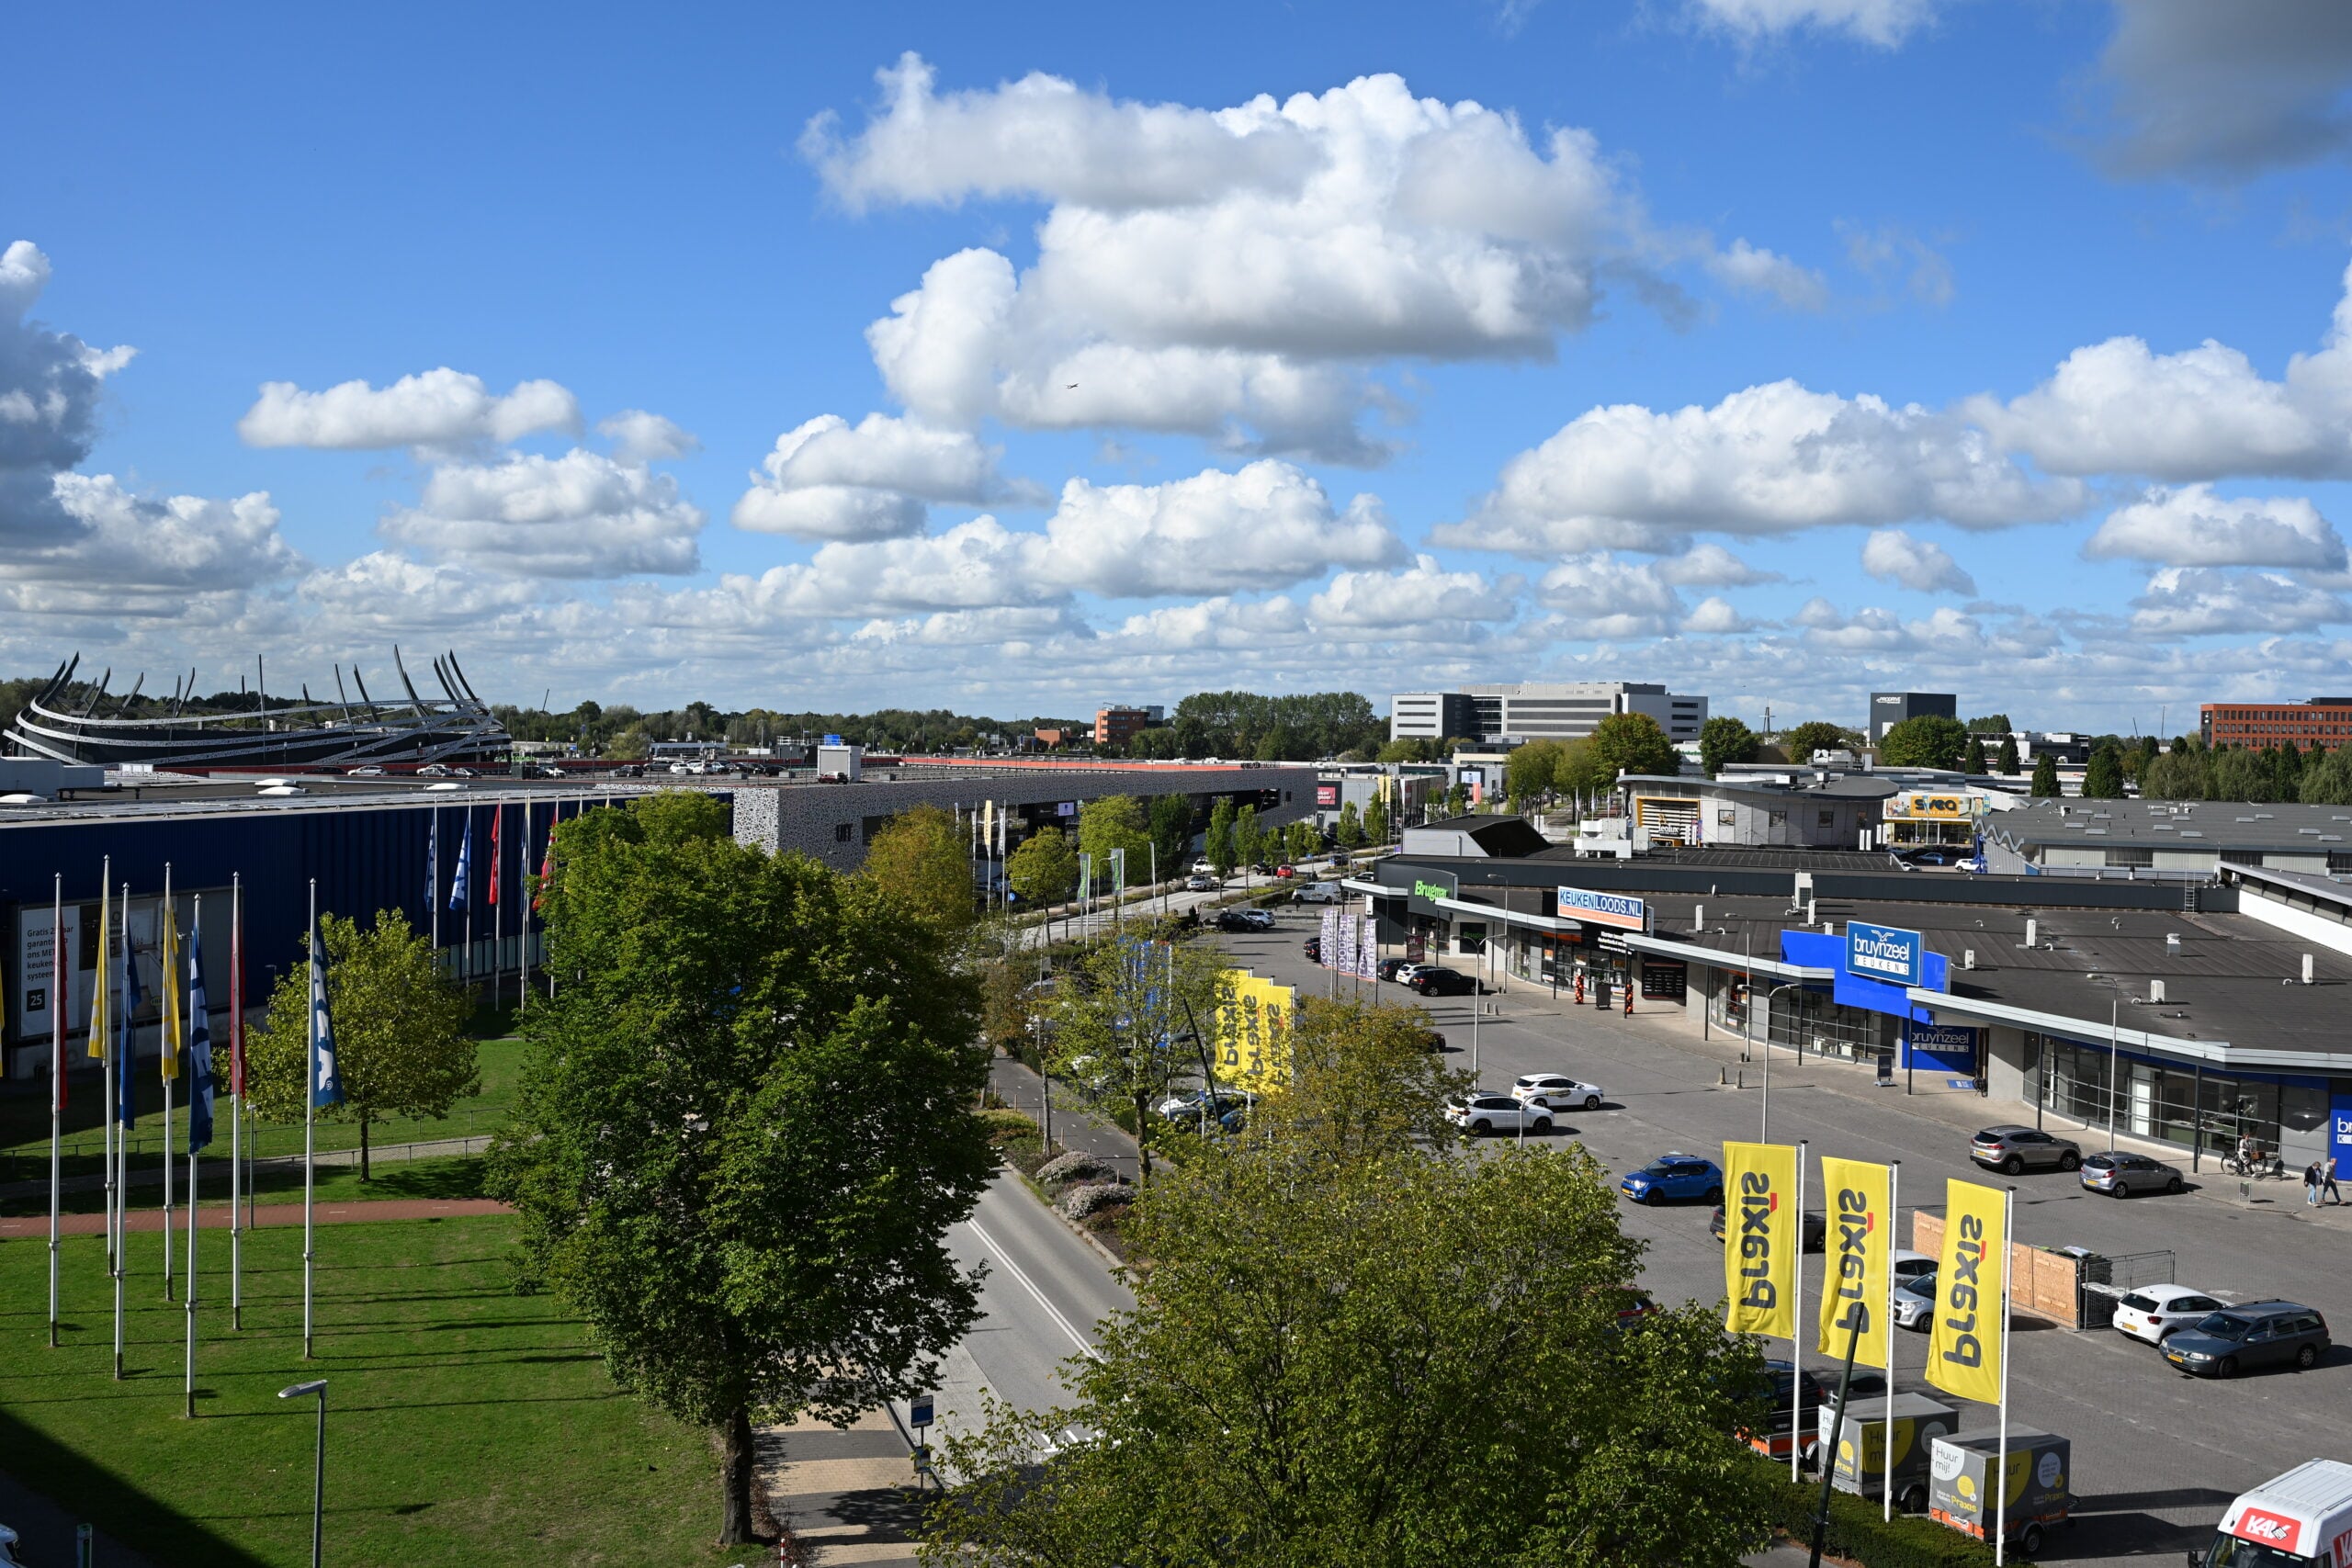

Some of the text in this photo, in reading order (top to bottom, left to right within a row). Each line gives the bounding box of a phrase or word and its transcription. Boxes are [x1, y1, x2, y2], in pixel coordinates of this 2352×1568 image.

[1560, 891, 1642, 917] KEUKENLOODS.NL
[27, 929, 49, 937] Gratis
[27, 950, 40, 959] ons
[1854, 933, 1910, 962] bruynzeel
[1854, 956, 1908, 974] KEUKENS
[29, 994, 42, 1006] 25
[1936, 1446, 1959, 1462] Huur
[1935, 1461, 1951, 1474] mij!
[1951, 1495, 1978, 1513] Praxis
